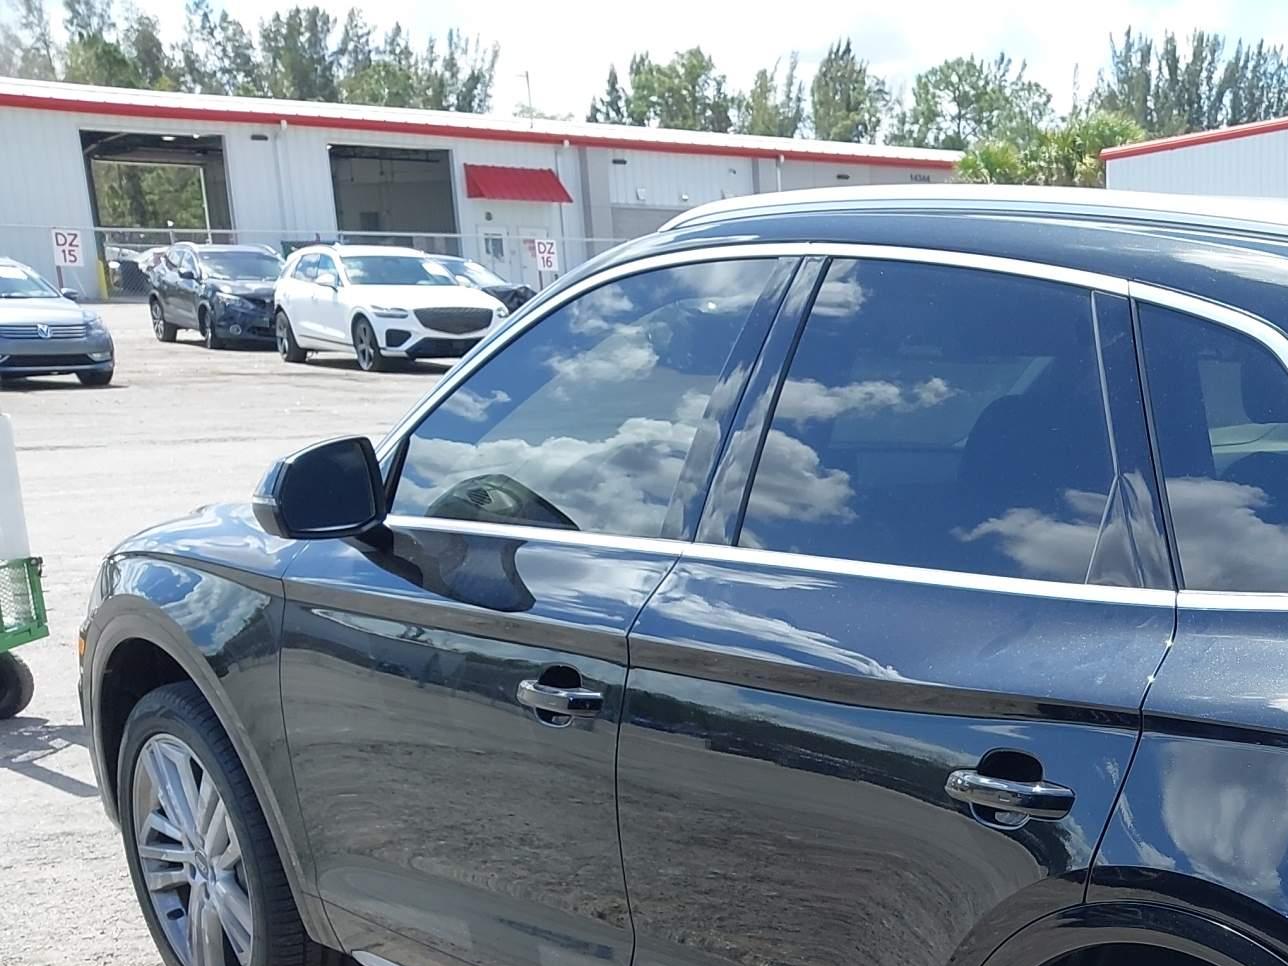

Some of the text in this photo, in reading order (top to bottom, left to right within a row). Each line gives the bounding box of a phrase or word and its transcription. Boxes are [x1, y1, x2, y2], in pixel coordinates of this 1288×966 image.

[55, 232, 79, 247] DZ
[537, 241, 555, 255] DZ
[62, 249, 78, 263] 15
[541, 256, 553, 268] 16
